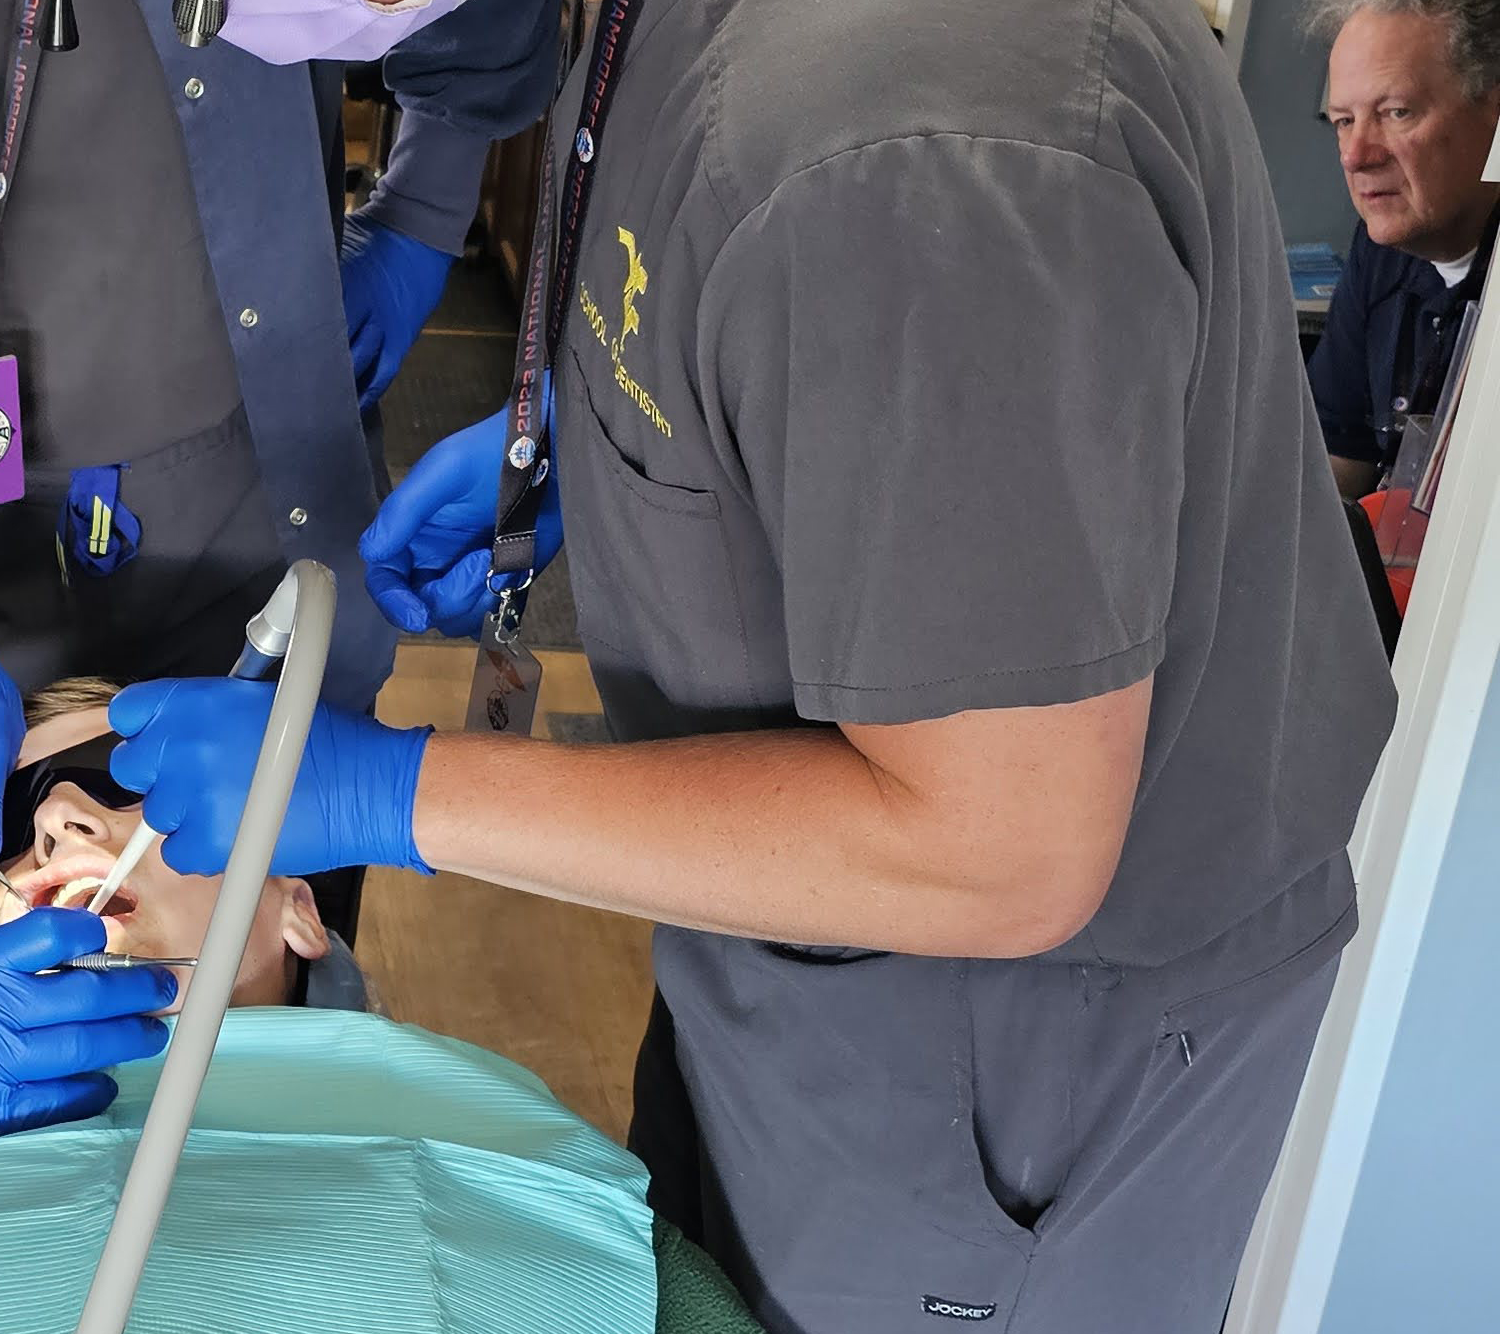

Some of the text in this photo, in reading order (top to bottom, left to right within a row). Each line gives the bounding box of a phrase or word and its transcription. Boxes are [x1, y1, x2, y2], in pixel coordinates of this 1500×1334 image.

[525, 239, 547, 361] NATIONAL
[517, 368, 537, 433] 2023
[614, 357, 673, 438] DENTISTRY
[928, 1301, 993, 1318] JOCKEY
